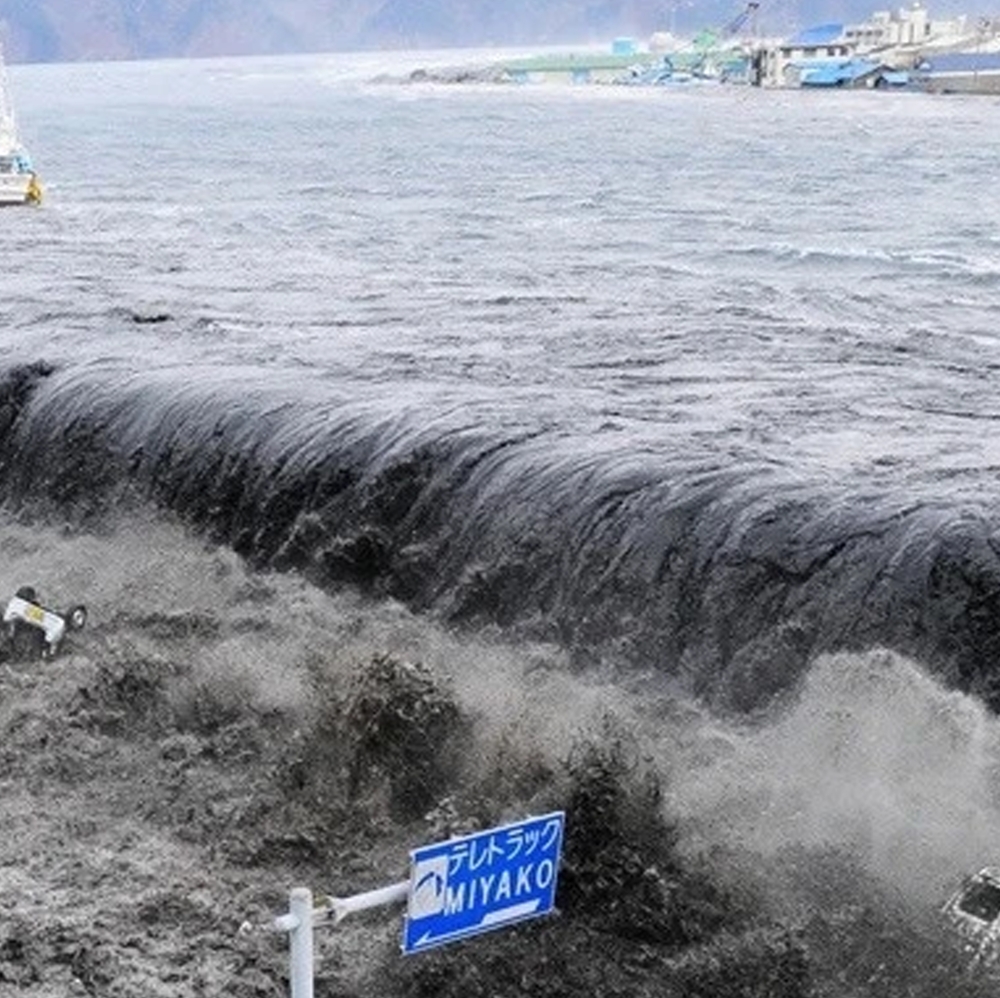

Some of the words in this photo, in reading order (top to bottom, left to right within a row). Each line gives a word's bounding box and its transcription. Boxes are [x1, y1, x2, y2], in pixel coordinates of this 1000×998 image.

[448, 819, 561, 877] テレトラック
[443, 859, 553, 917] MIYAKO
